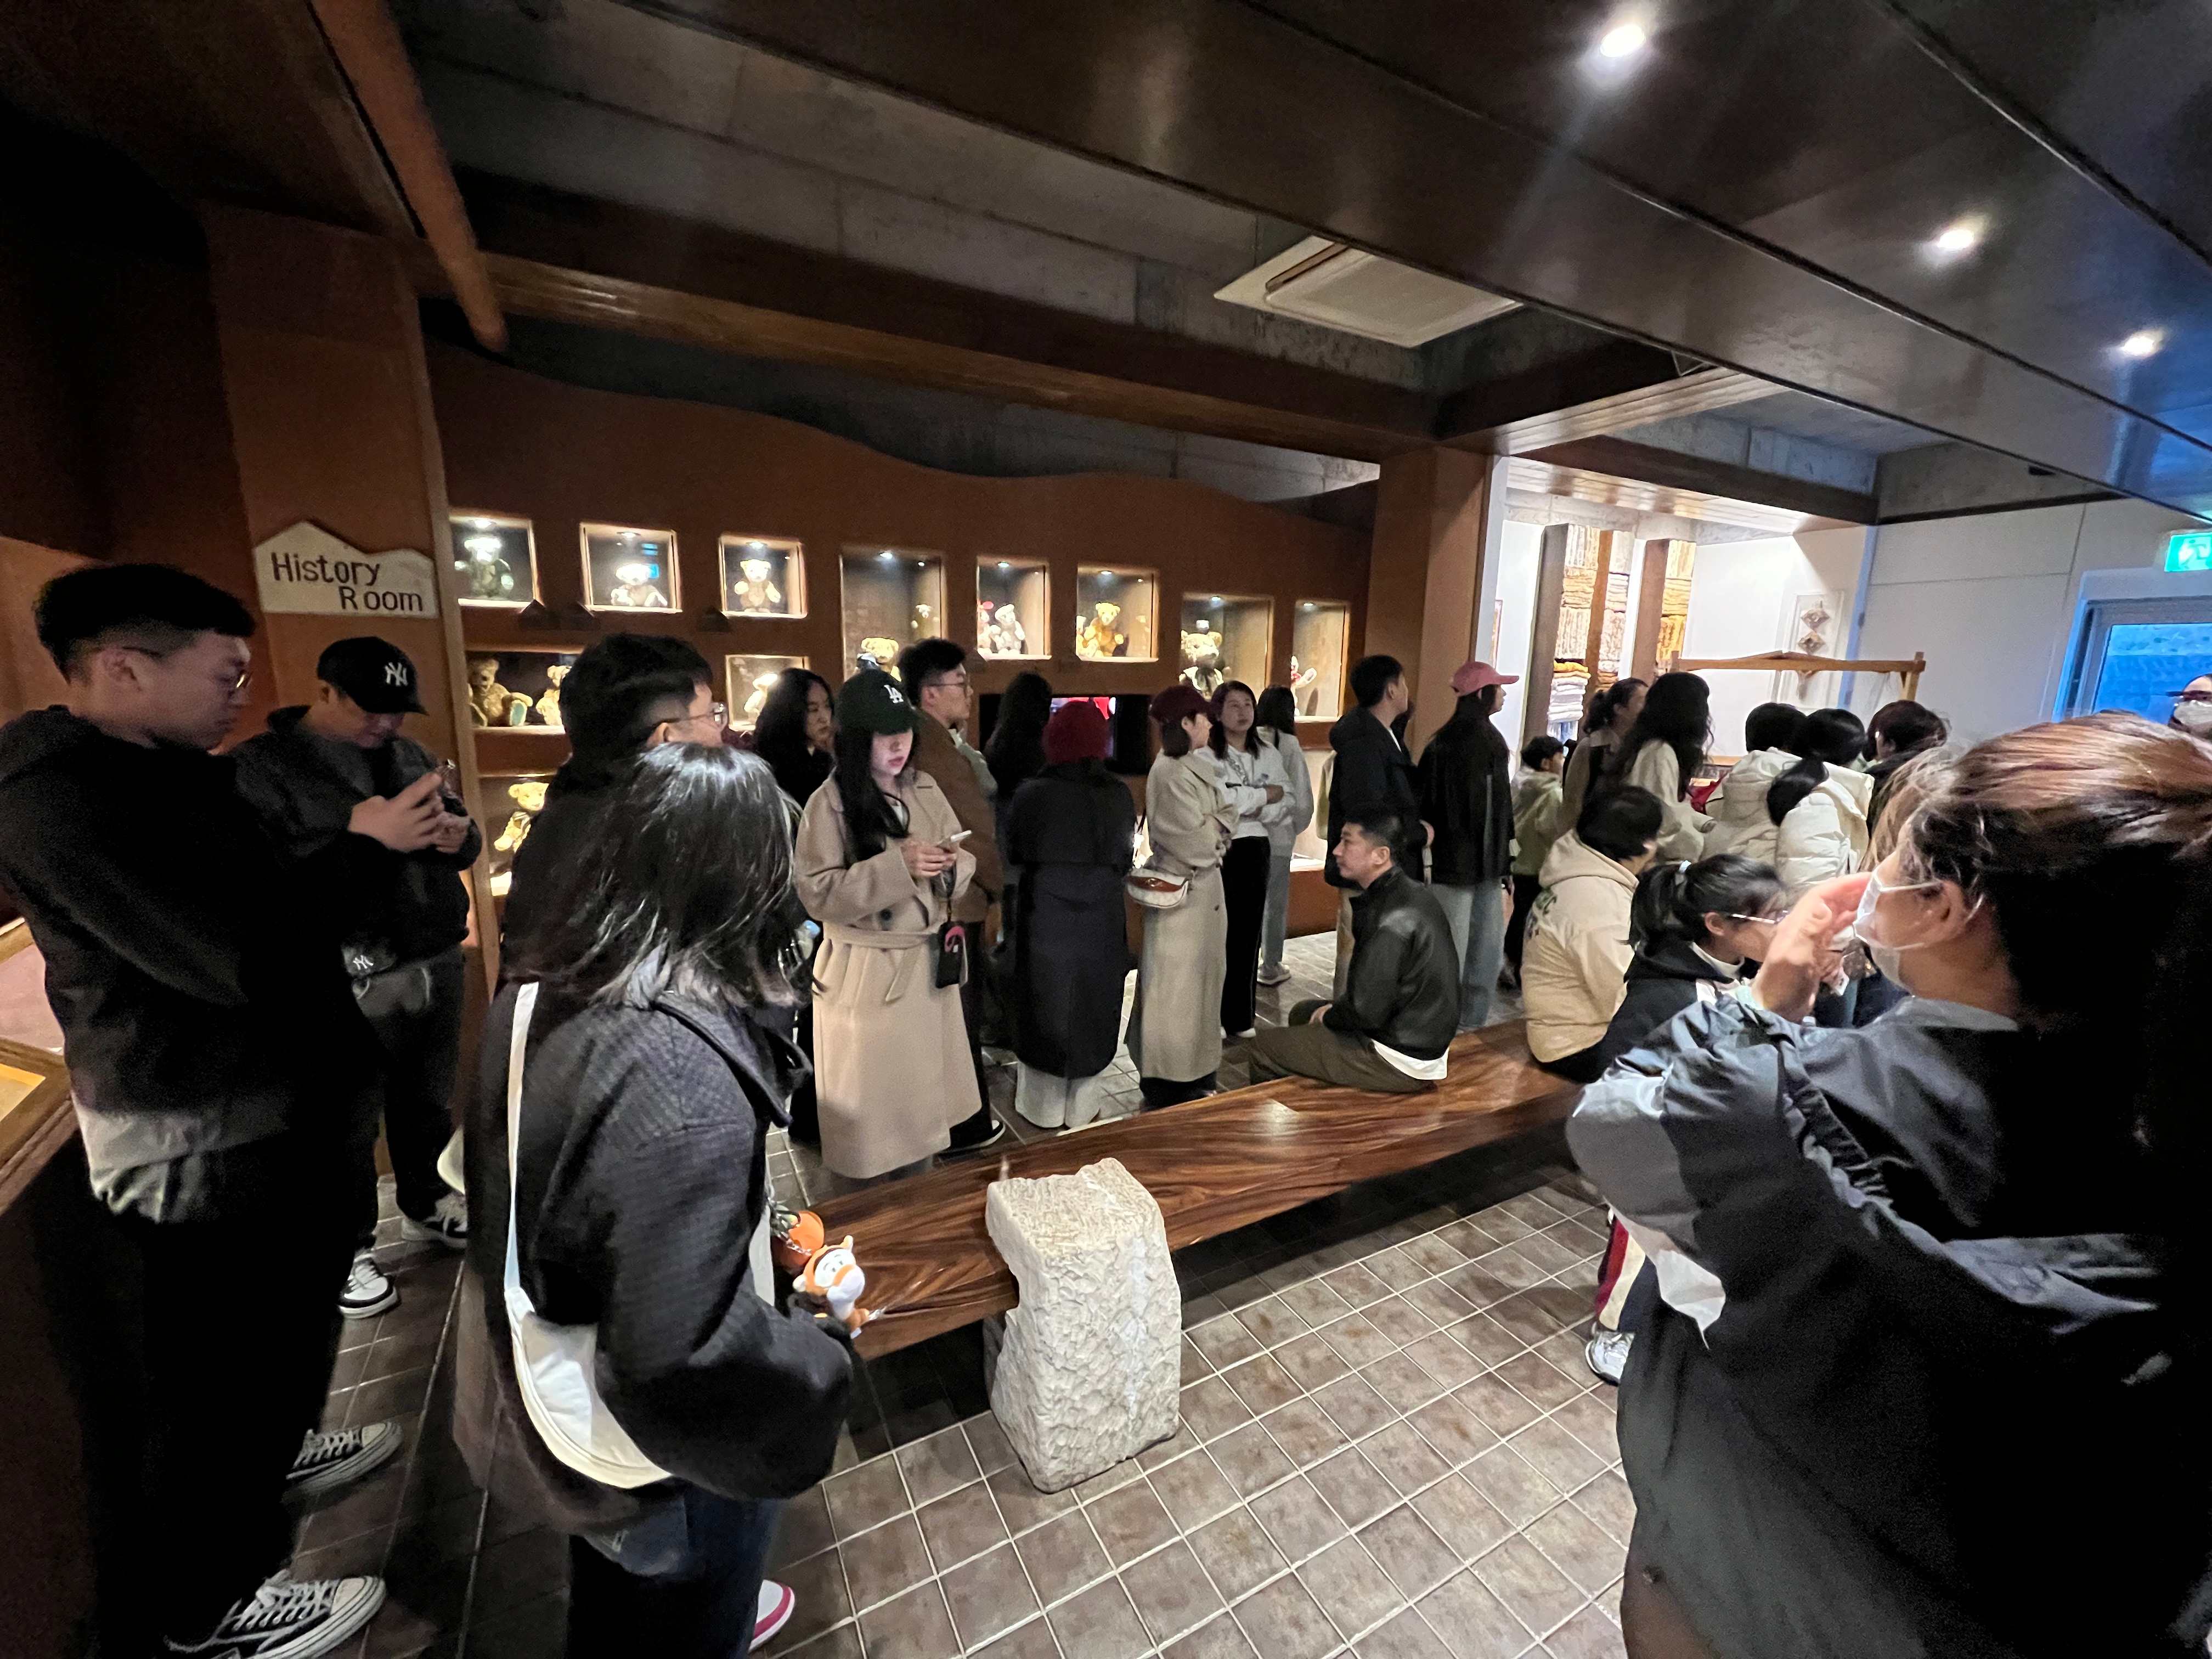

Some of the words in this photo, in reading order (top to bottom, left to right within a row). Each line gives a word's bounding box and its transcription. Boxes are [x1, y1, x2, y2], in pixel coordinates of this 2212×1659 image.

[271, 552, 381, 586] History
[338, 585, 424, 612] Room
[385, 662, 408, 686] NY
